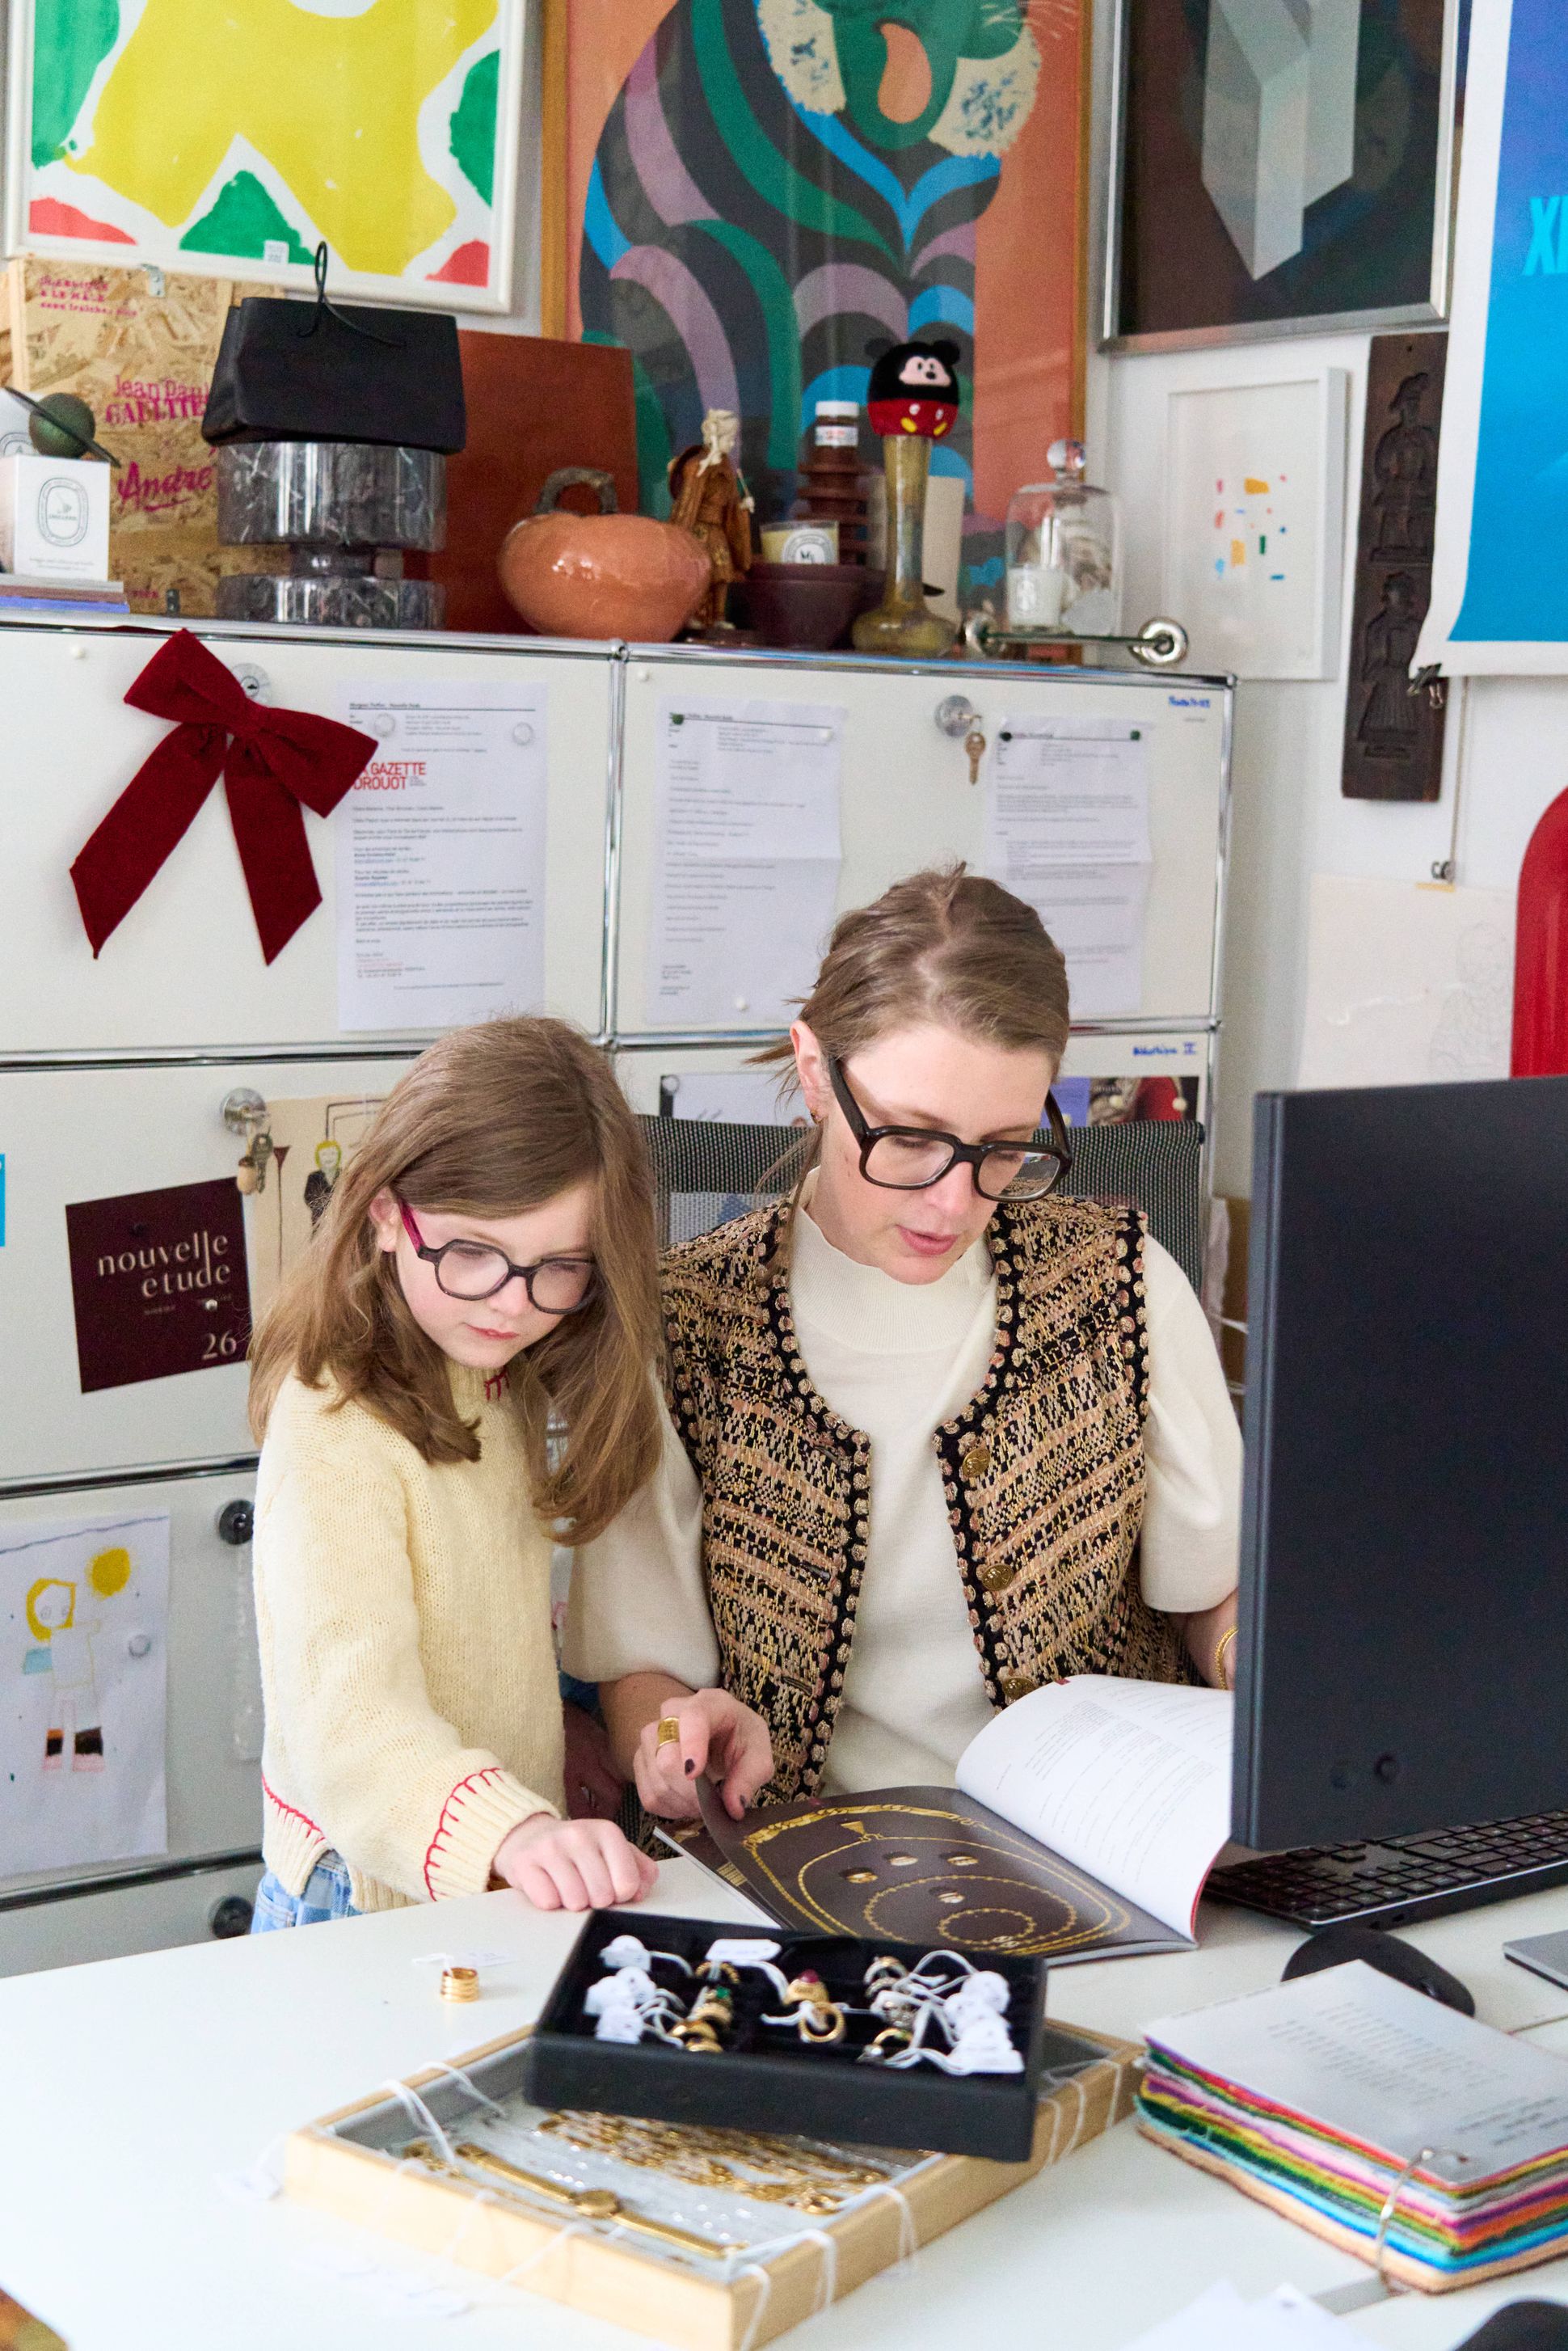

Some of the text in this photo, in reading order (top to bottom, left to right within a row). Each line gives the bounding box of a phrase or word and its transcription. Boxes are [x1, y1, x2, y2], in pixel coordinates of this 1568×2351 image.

[114, 374, 160, 399] Jean
[106, 395, 206, 425] GAULTIE
[370, 762, 427, 776] GAZETTE
[99, 1230, 228, 1277] nouvelle
[202, 1330, 237, 1360] 26
